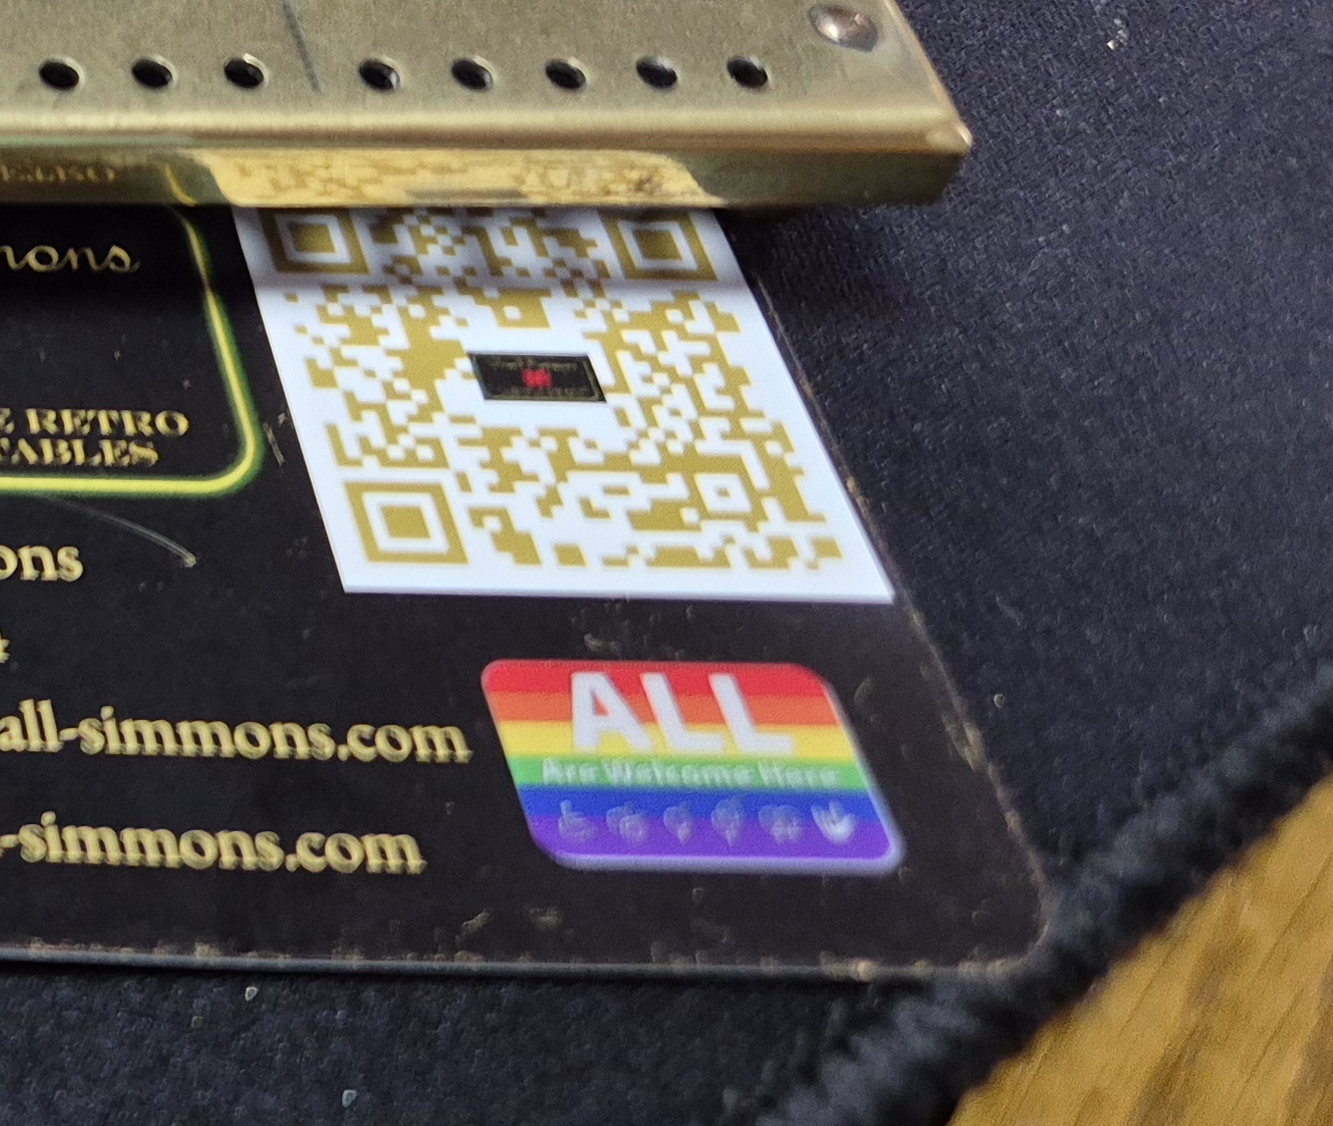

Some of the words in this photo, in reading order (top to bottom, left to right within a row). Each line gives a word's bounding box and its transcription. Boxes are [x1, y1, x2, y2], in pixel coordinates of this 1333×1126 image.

[25, 409, 191, 440] RETRO
[569, 670, 795, 755] ALL
[541, 756, 599, 786] Are
[601, 757, 755, 788] Welcome
